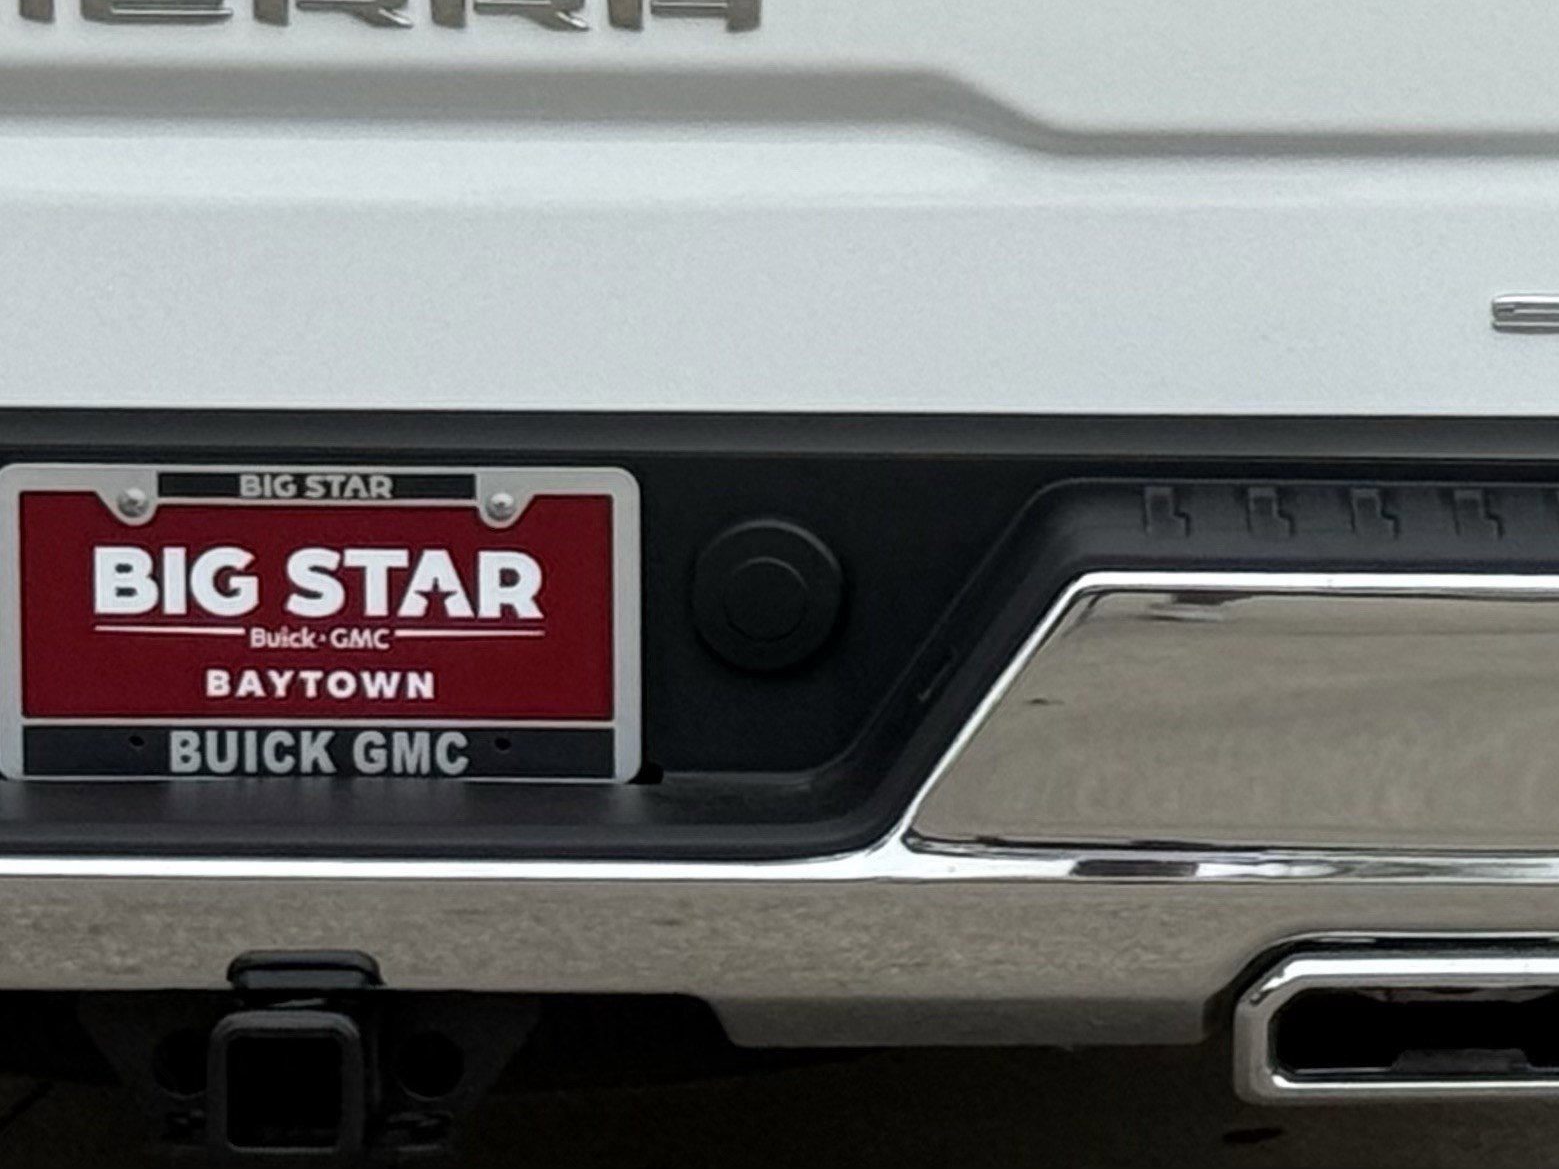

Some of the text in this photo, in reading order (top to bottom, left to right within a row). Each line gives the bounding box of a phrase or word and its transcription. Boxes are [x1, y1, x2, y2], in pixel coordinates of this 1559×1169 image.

[239, 474, 394, 499] BIG STAR
[93, 545, 544, 619] BIG STAR
[205, 669, 435, 699] BAYTOWN
[169, 730, 470, 776] BUICK GMC
